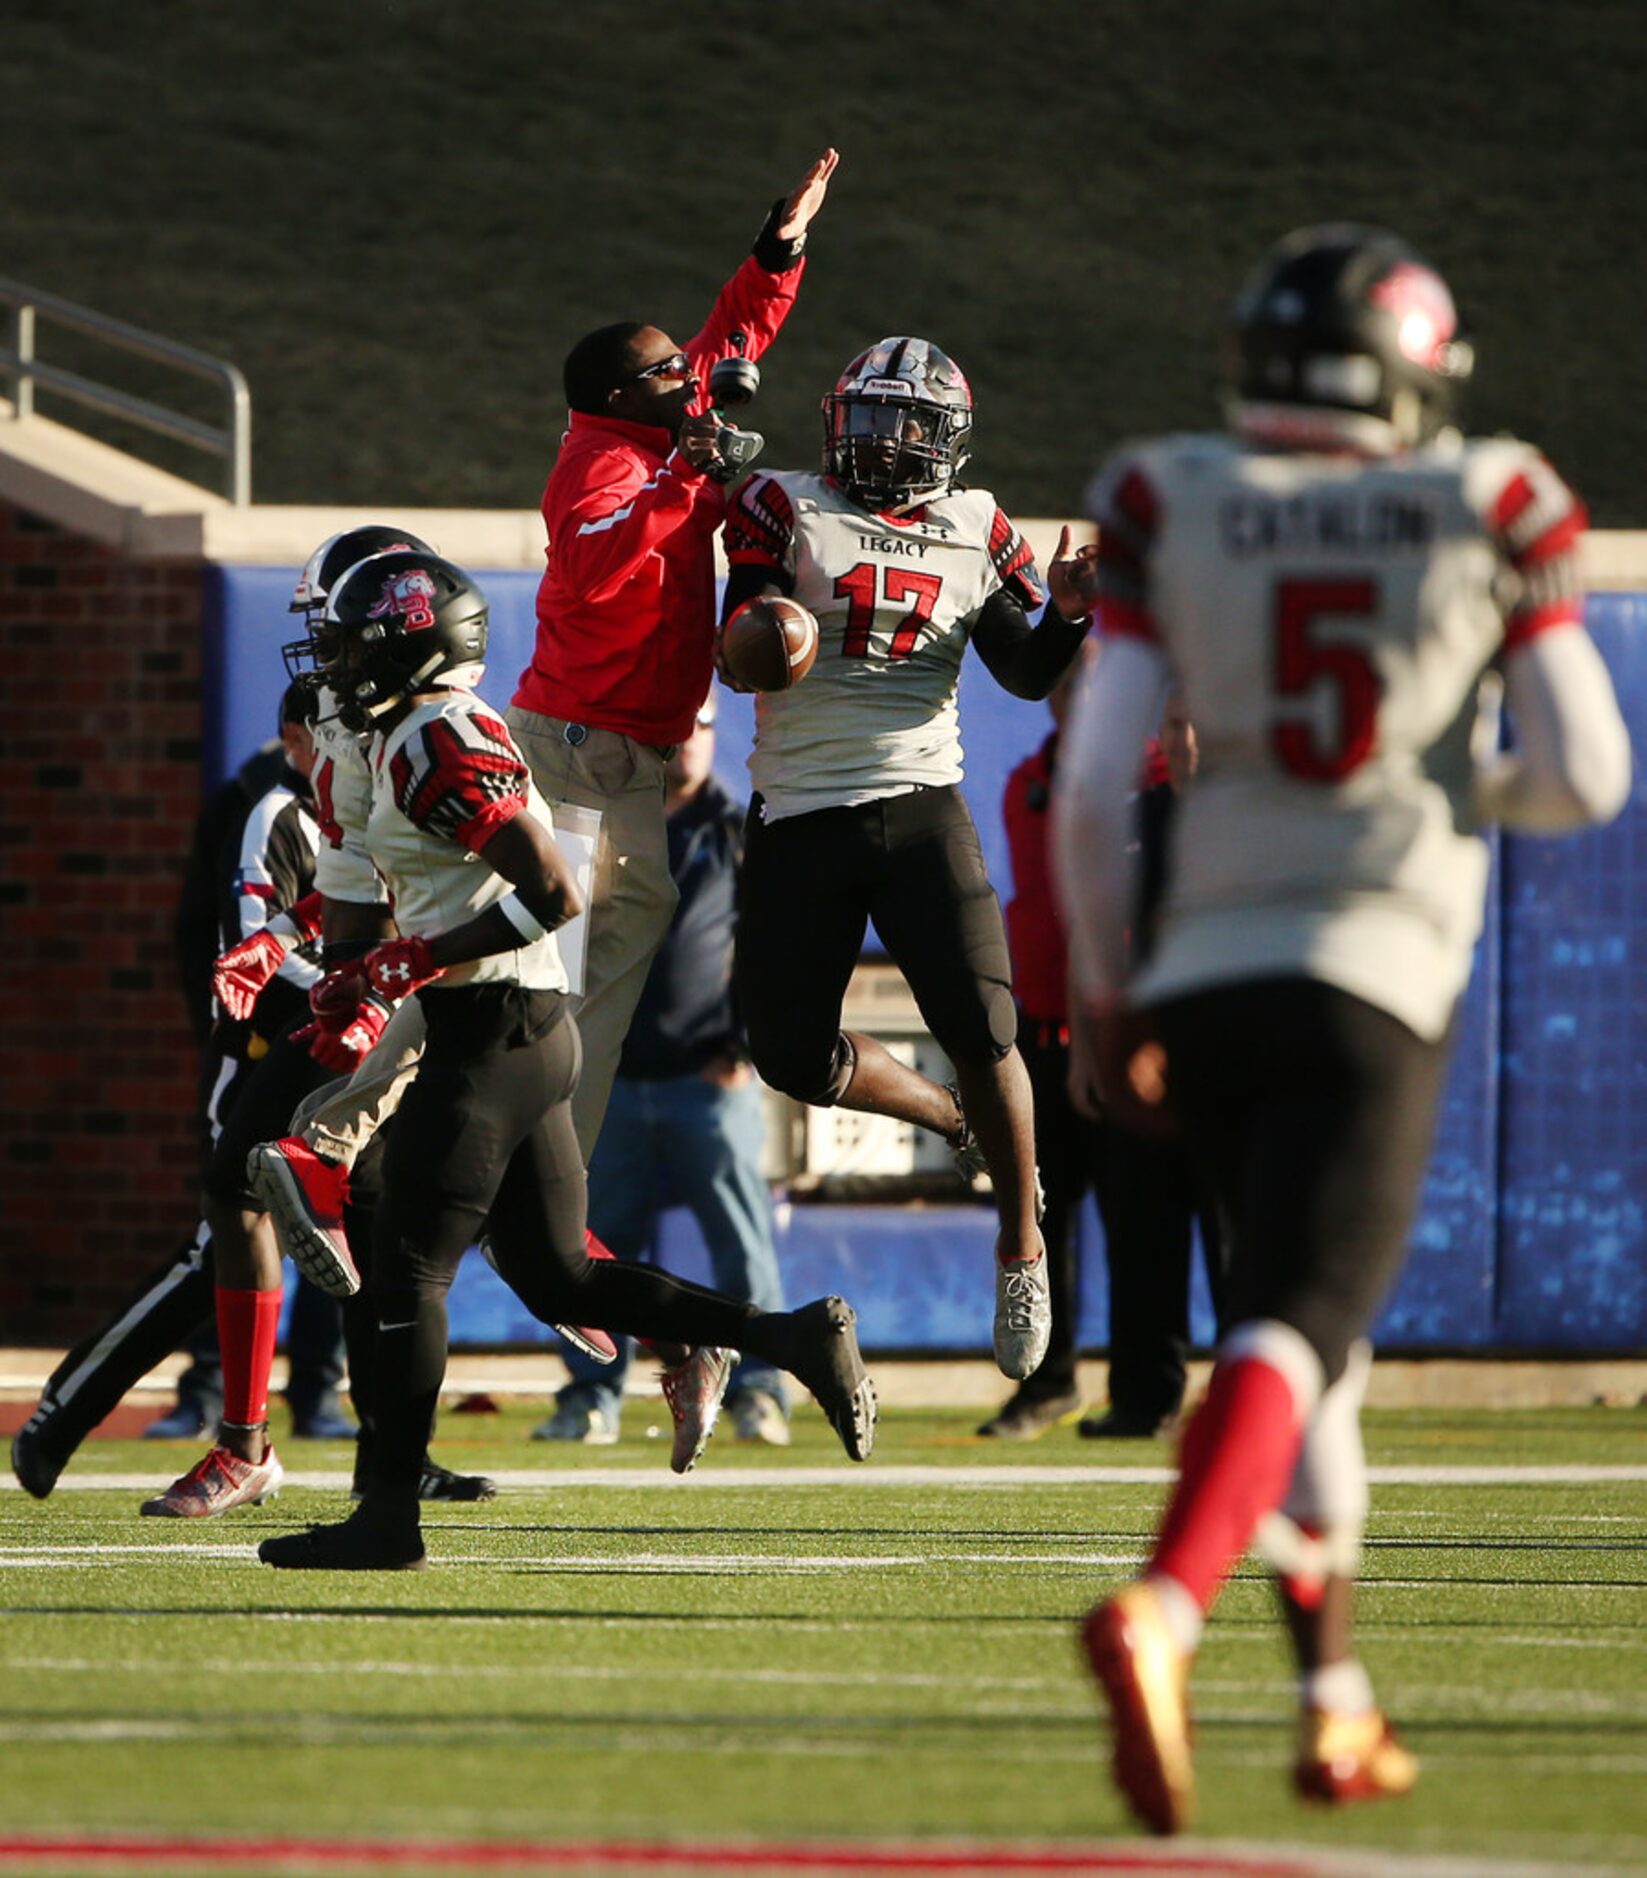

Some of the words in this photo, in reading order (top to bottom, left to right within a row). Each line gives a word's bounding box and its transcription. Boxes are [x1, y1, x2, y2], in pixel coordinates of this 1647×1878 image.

[859, 535, 928, 558] LEGACY
[833, 561, 943, 660] 17
[1269, 574, 1386, 785] 5
